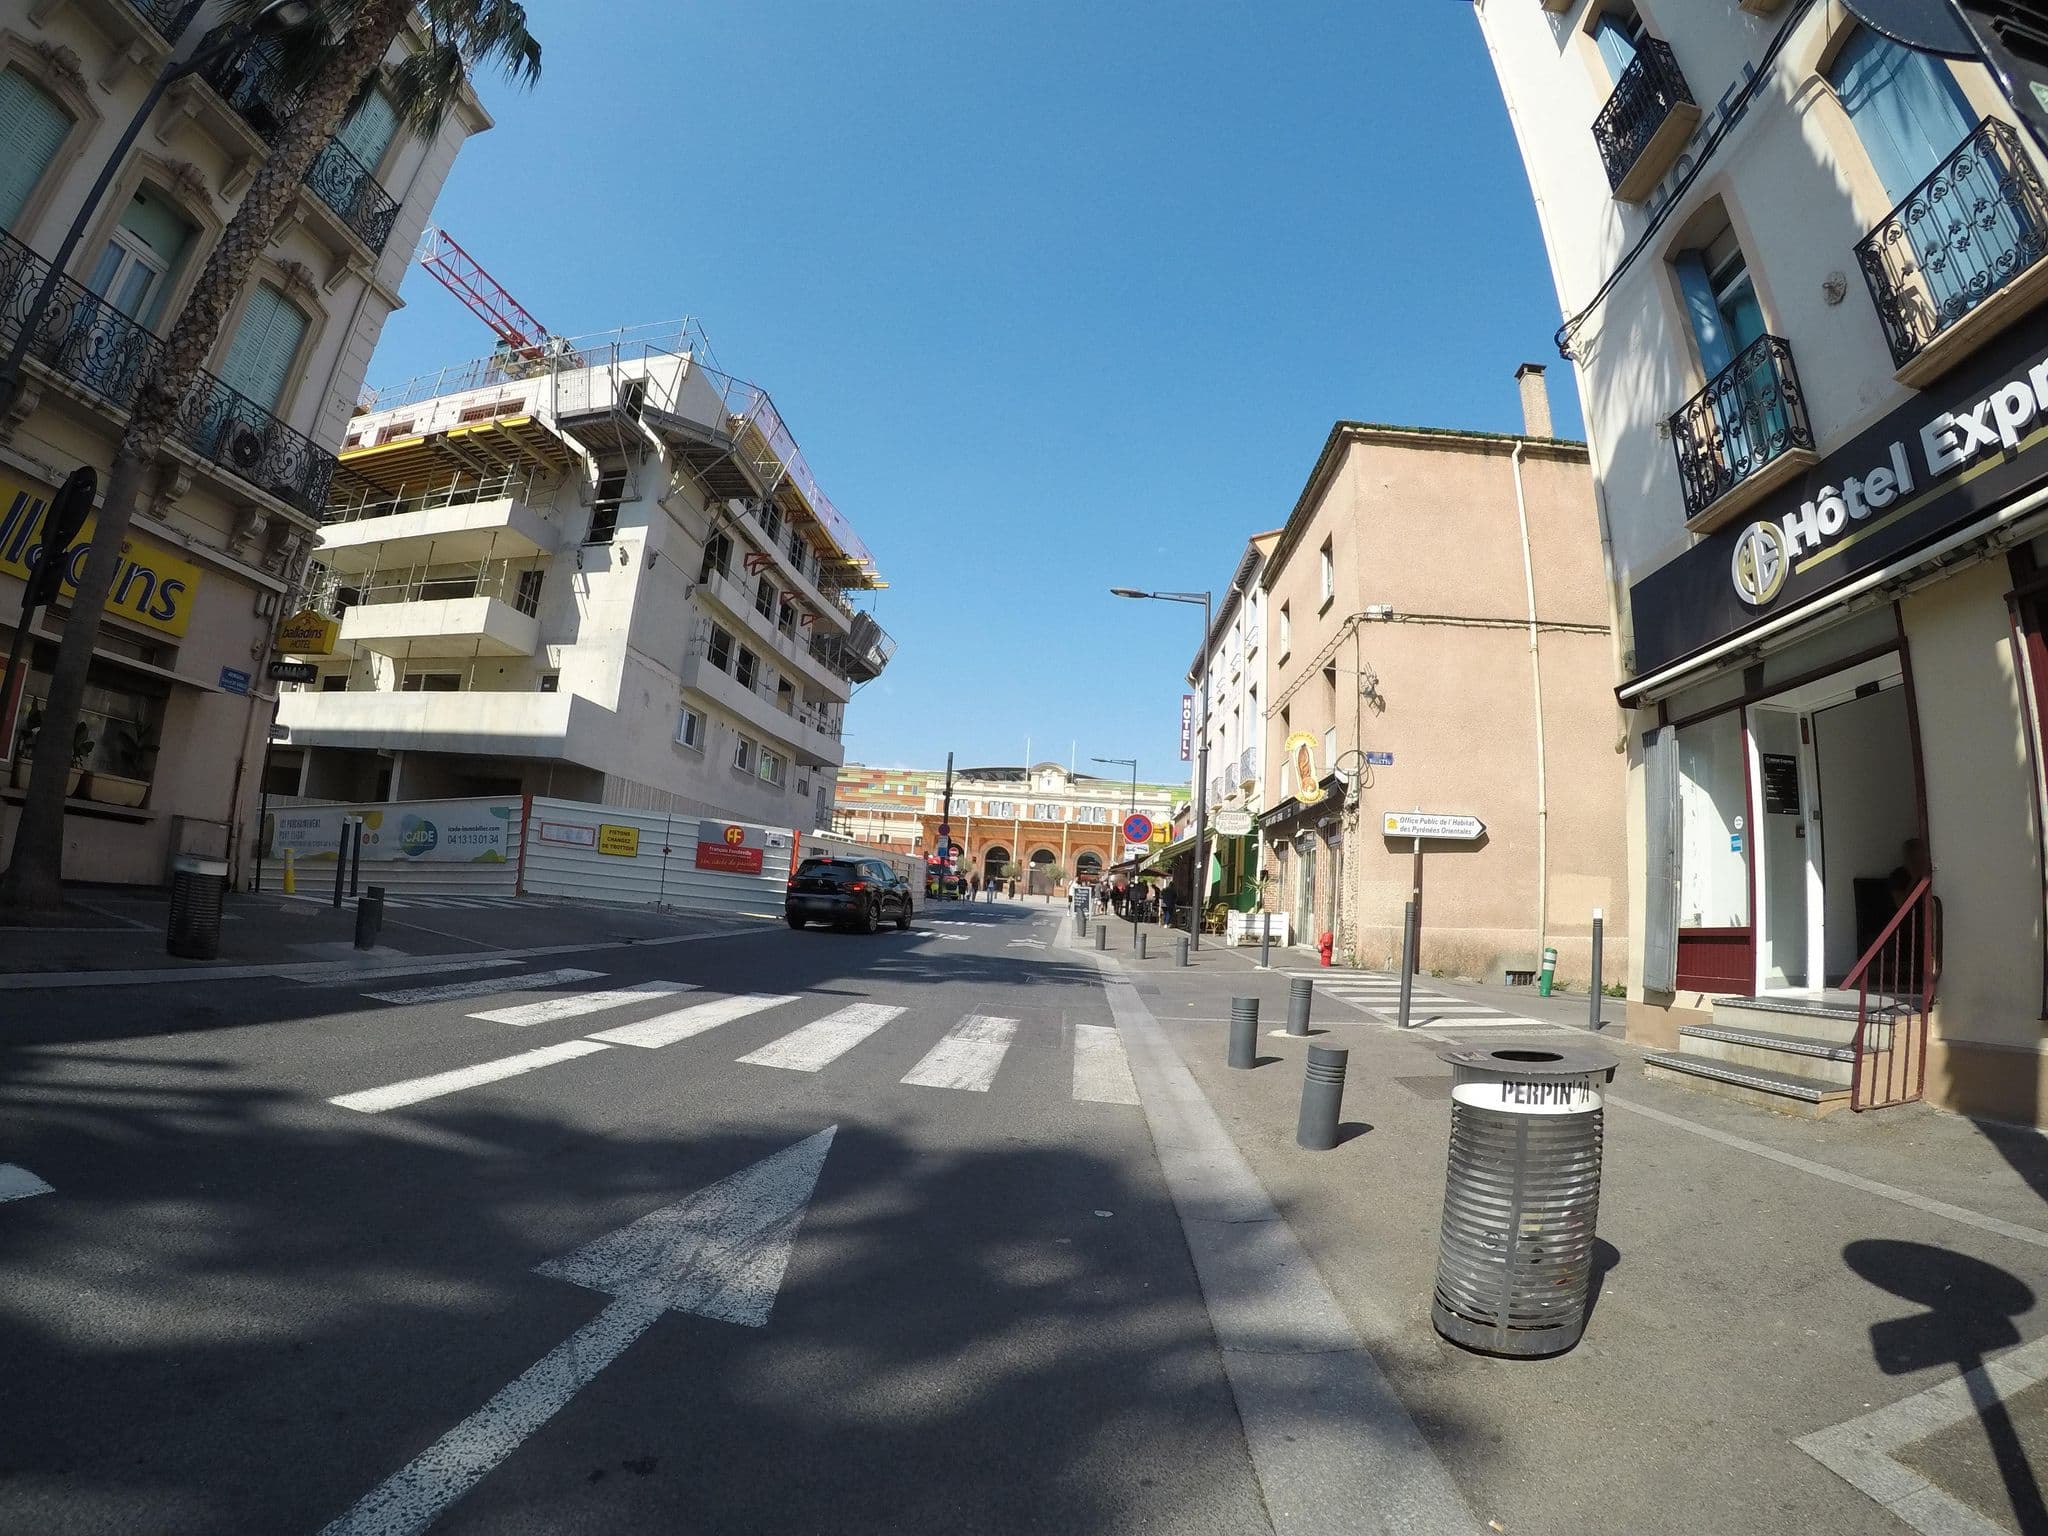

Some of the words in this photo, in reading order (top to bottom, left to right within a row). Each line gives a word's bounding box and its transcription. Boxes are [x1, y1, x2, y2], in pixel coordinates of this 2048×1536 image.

[1782, 441, 1915, 558] Hôtel
[282, 625, 323, 638] balladins
[290, 639, 310, 649] HOTEL
[1400, 817, 1418, 825] Office
[1453, 819, 1475, 827] Habitat
[727, 828, 742, 843] FF
[1412, 826, 1440, 835] Pyrénées
[1441, 827, 1472, 835] Orientales
[489, 834, 499, 844] 34
